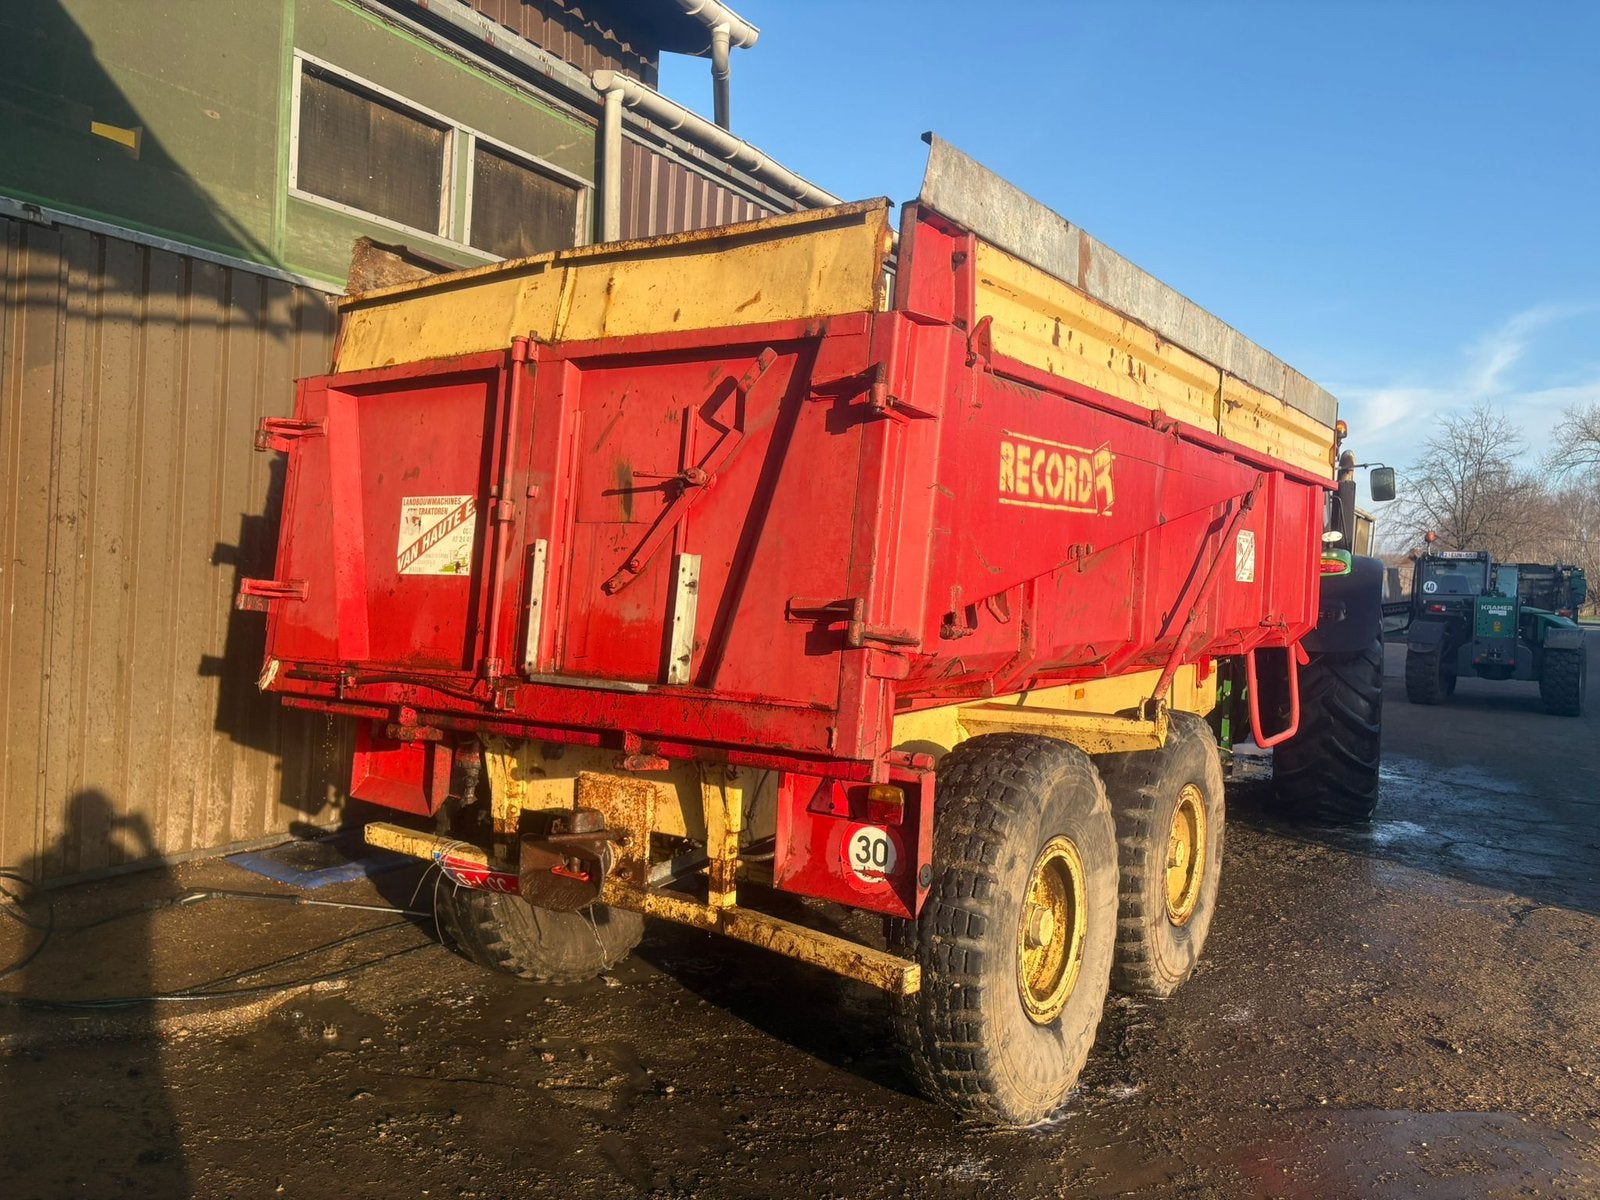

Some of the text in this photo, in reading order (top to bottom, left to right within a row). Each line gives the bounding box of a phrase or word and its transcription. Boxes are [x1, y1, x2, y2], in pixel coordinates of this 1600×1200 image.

[999, 441, 1093, 503] RECORD
[403, 497, 462, 506] LANDBOUWMACHINES
[398, 542, 419, 571] VAN
[422, 509, 462, 550] HAUTE
[1425, 582, 1436, 592] 40
[856, 835, 889, 867] 30
